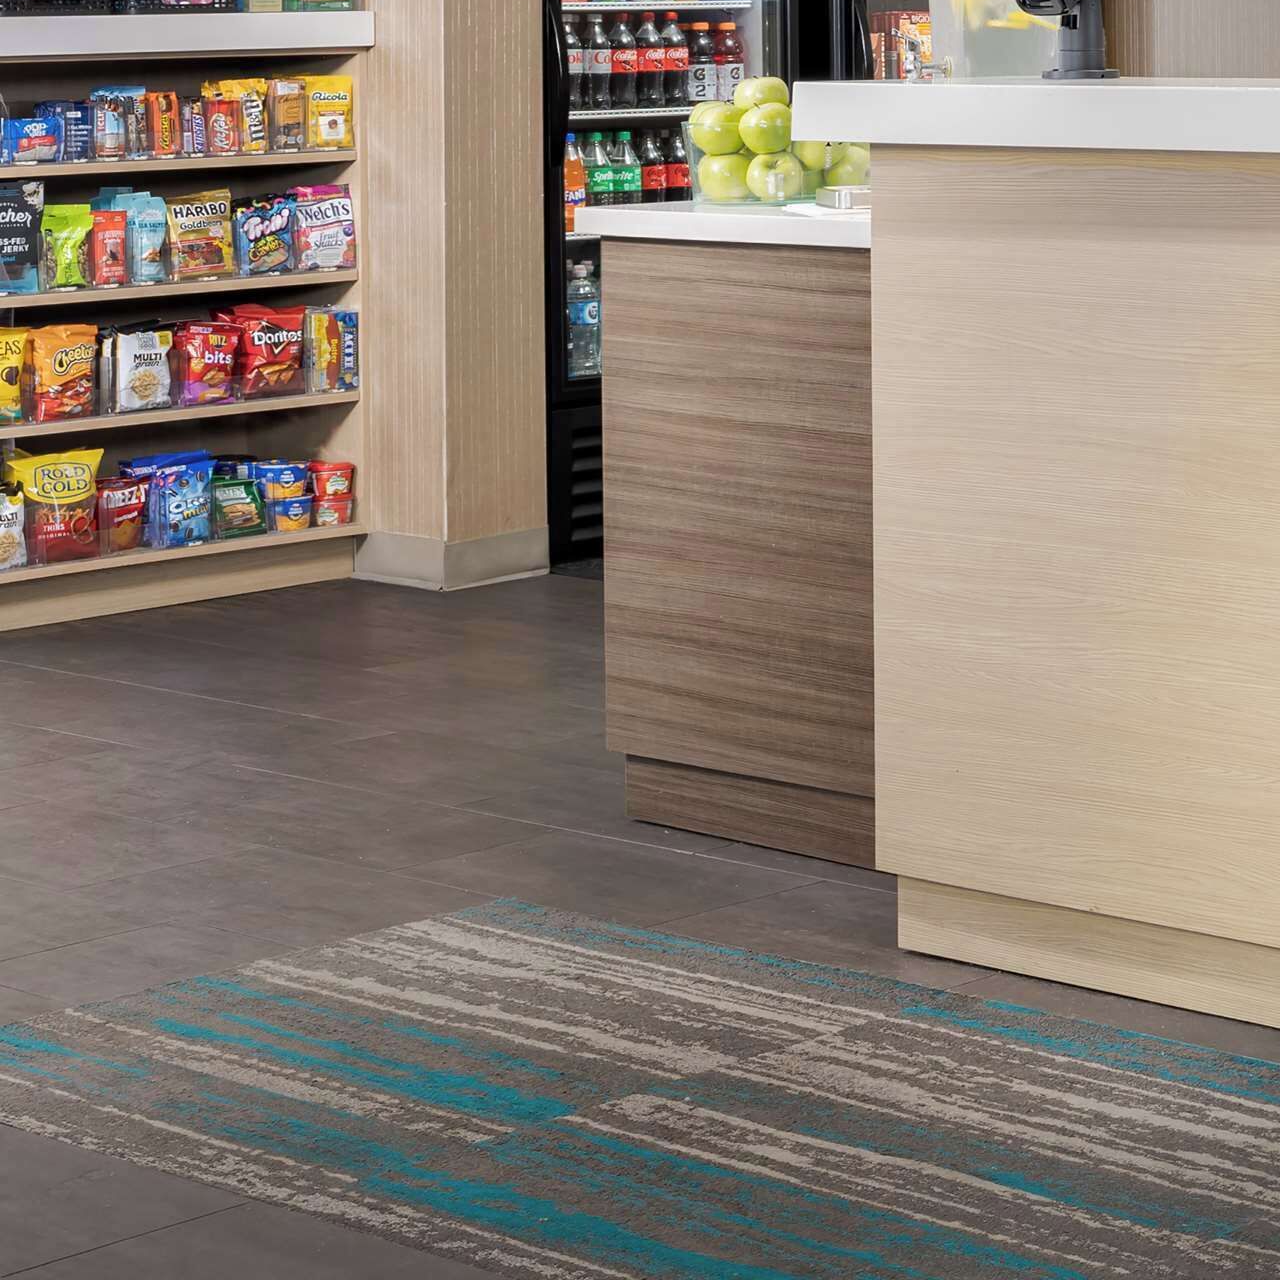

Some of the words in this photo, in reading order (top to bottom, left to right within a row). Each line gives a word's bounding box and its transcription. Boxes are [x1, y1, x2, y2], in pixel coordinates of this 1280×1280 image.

[311, 91, 348, 102] Ricola
[172, 201, 227, 220] HARIBO
[299, 201, 351, 221] Welch's
[2, 244, 30, 253] JERKY
[251, 330, 303, 346] Doritos
[133, 352, 162, 363] MULTI
[204, 350, 233, 364] bits
[40, 466, 86, 481] ROLD
[41, 478, 88, 495] GOLD
